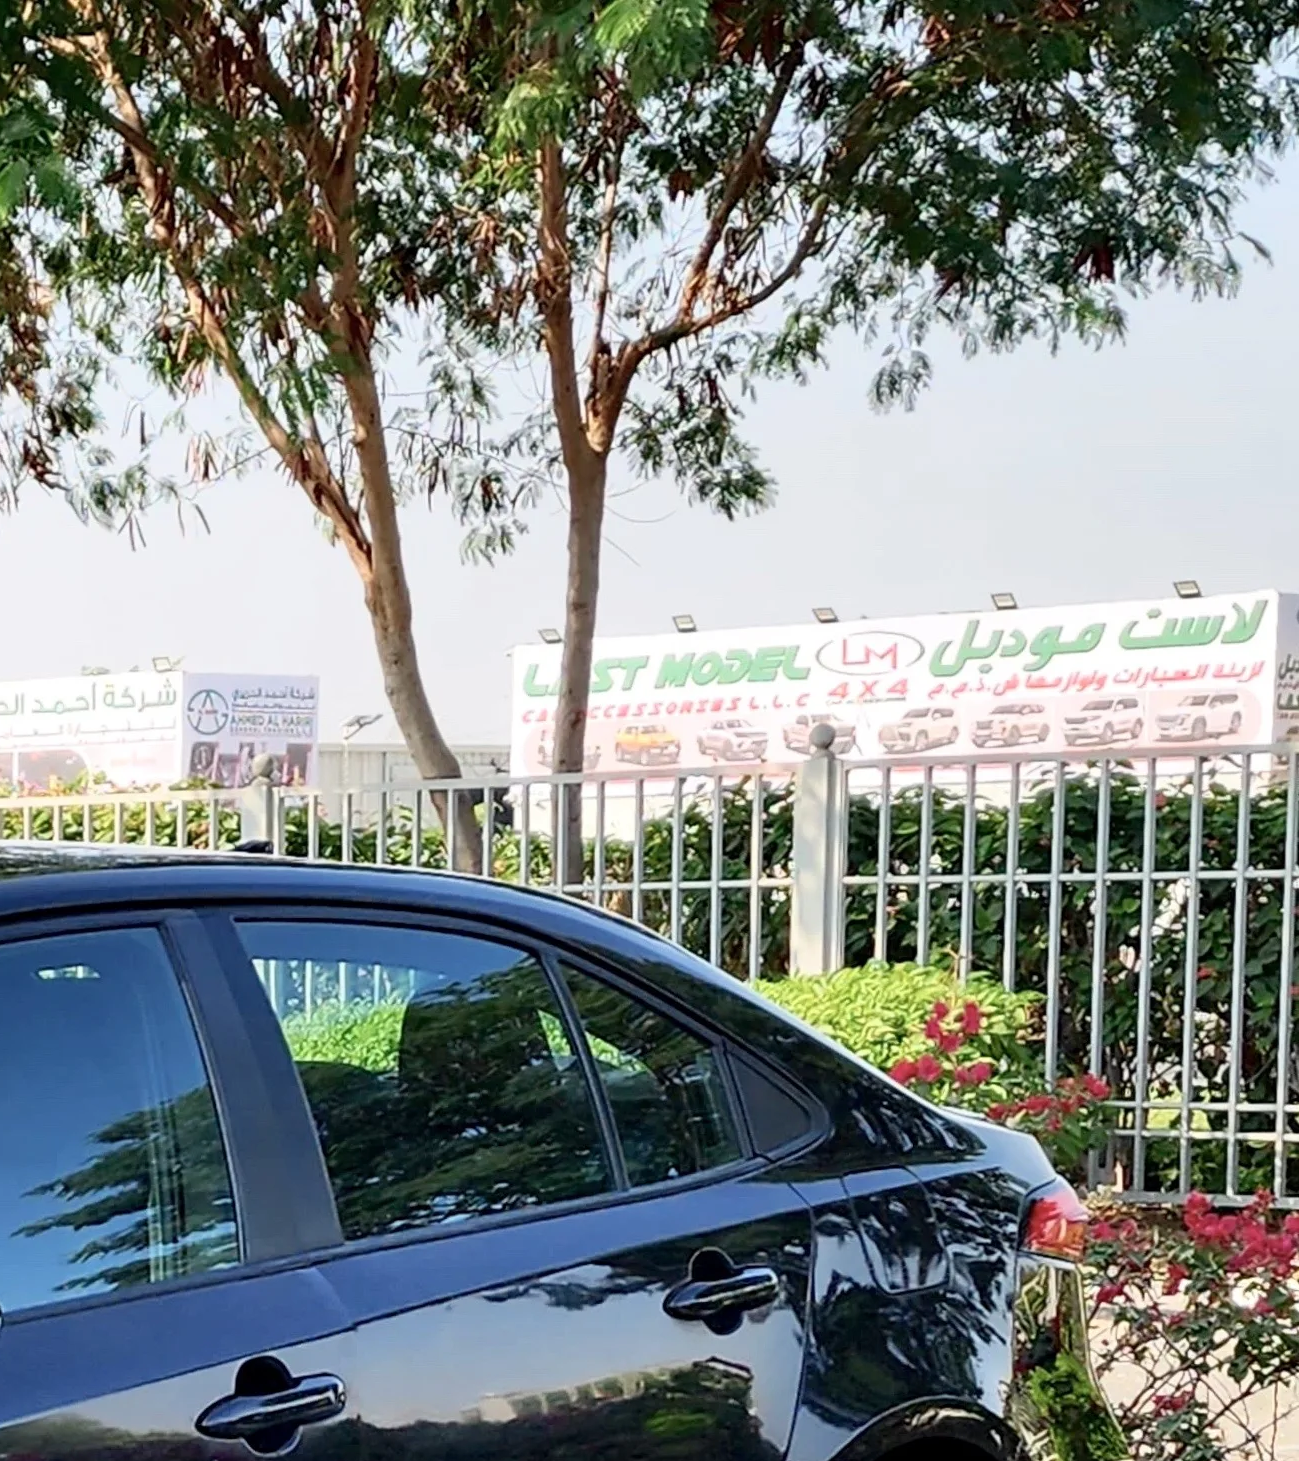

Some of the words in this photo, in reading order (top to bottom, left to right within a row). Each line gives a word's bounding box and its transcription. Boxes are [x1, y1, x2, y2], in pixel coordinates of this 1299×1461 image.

[929, 619, 1106, 677] موديل
[1119, 600, 1269, 650] لاست
[103, 678, 177, 713] شركة
[523, 656, 650, 697] LST
[655, 645, 811, 689] MODEL
[583, 697, 741, 719] CCESSORIES
